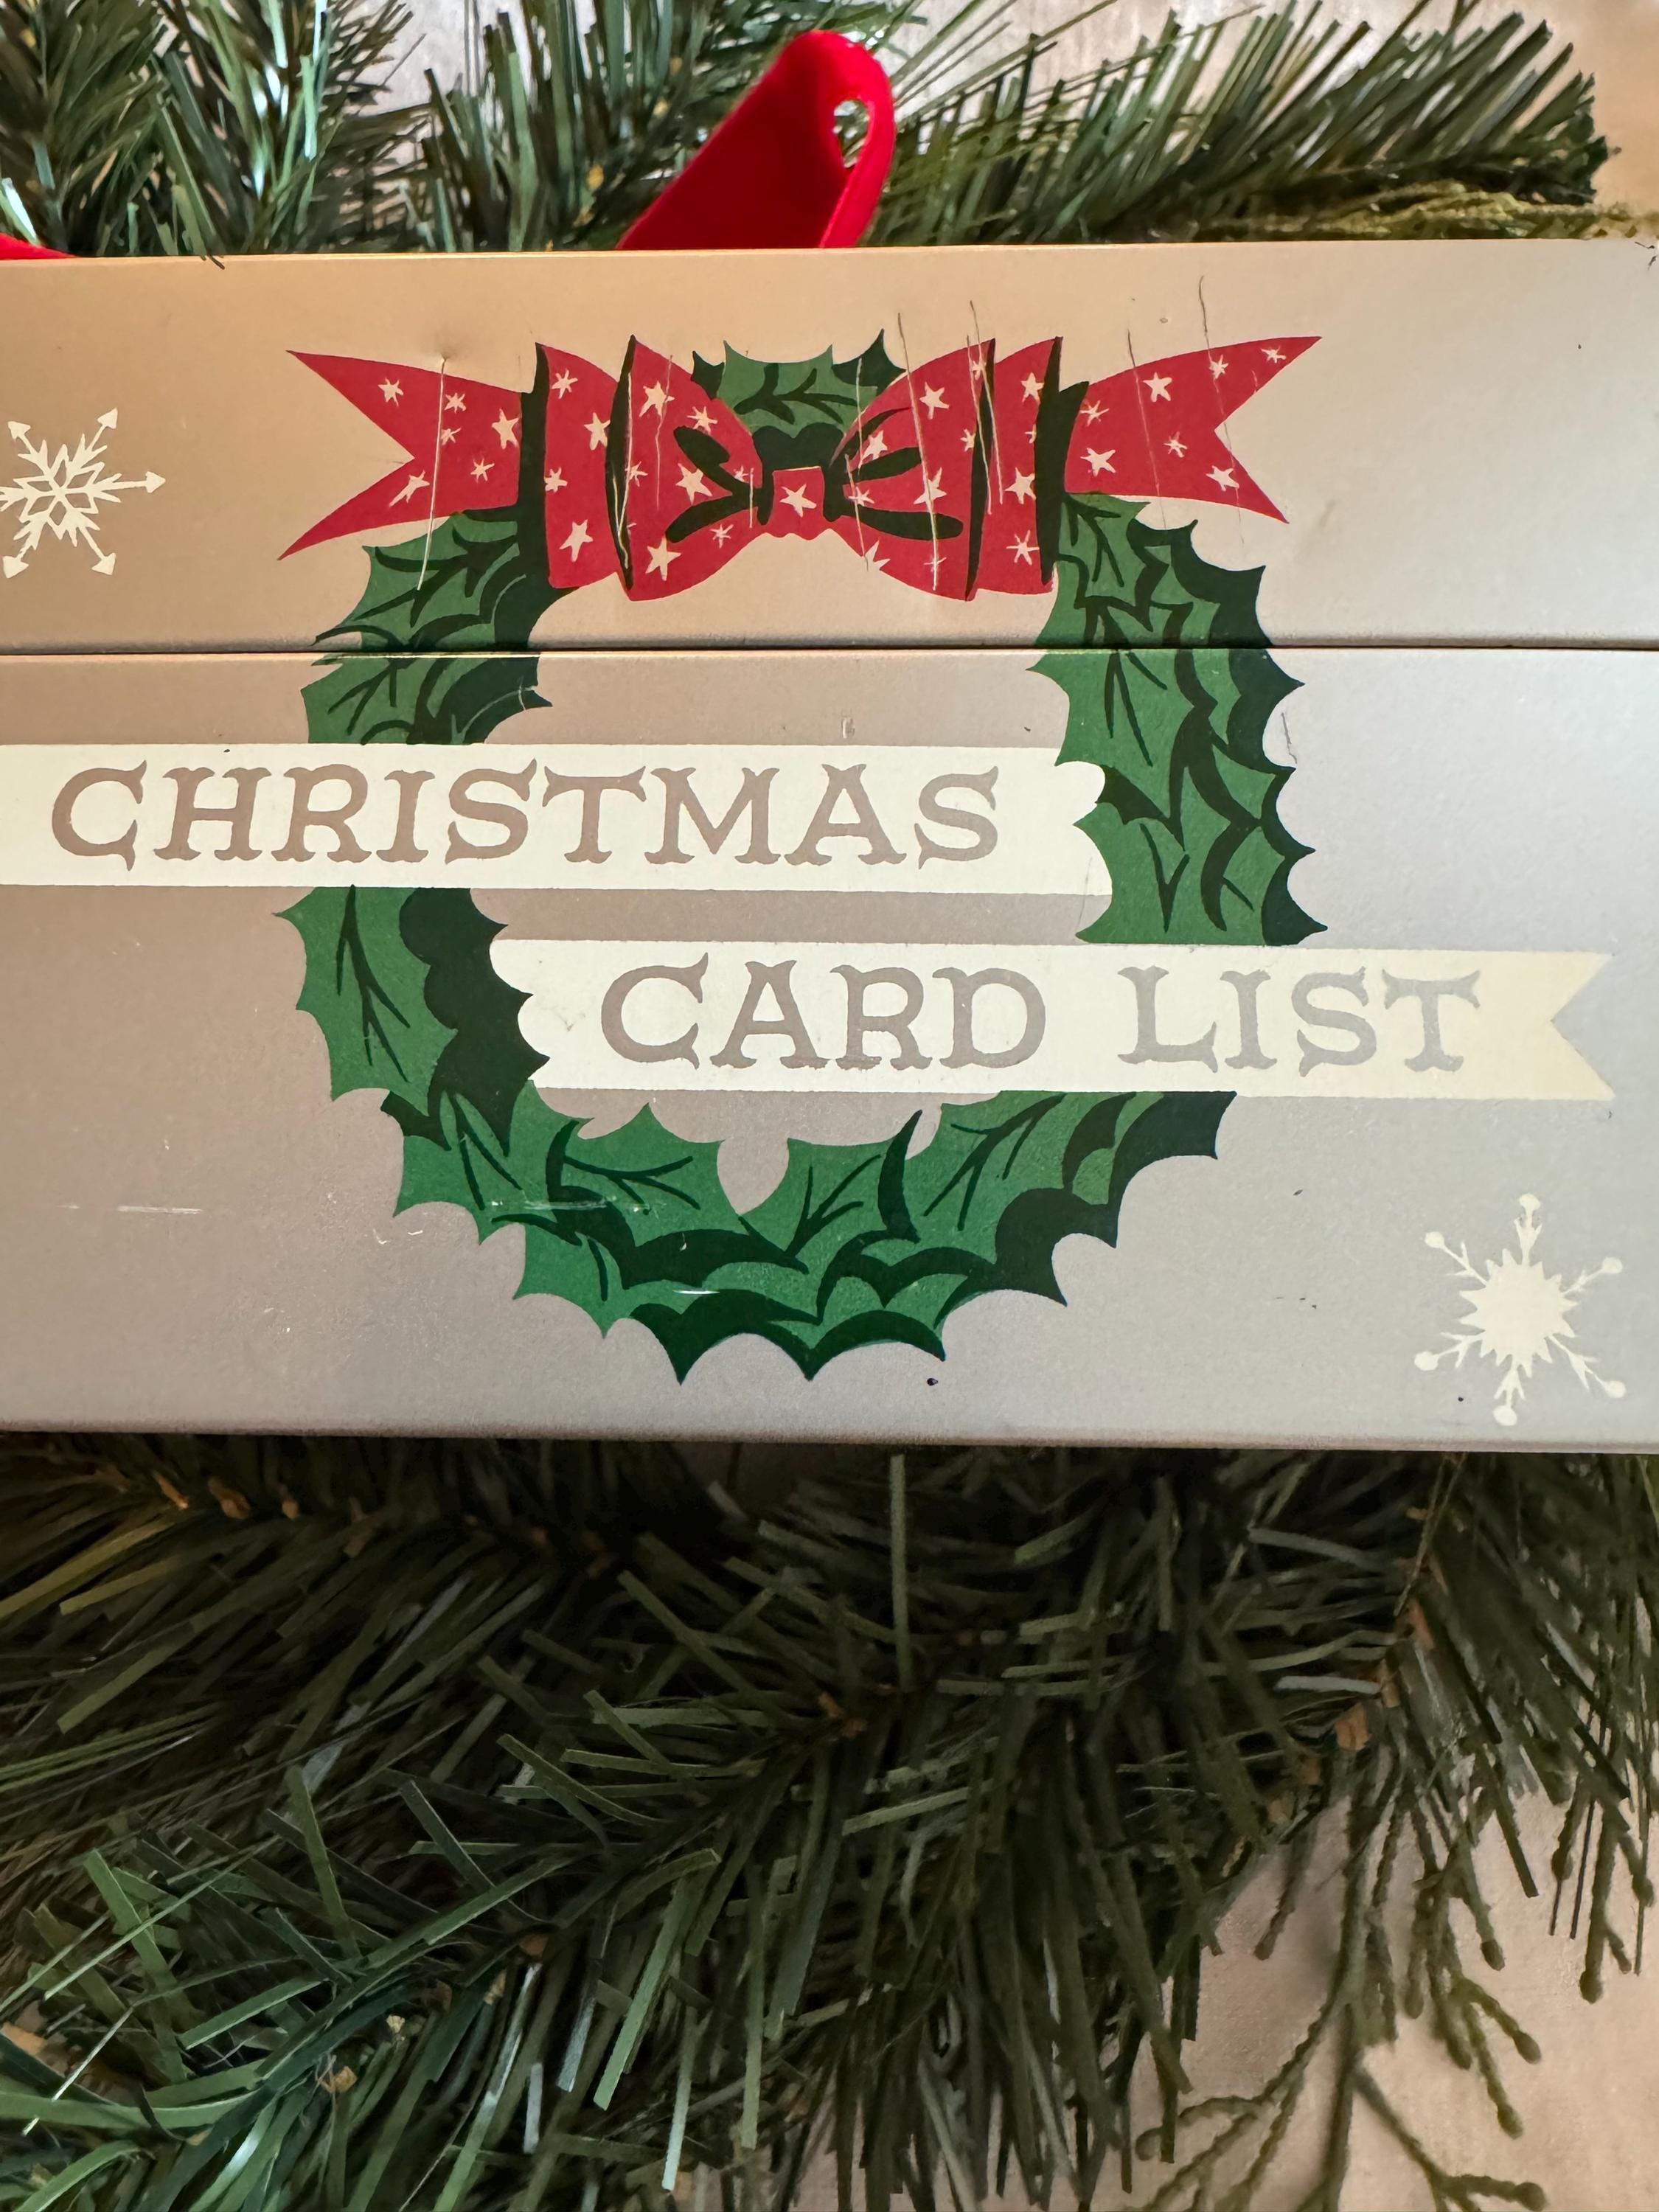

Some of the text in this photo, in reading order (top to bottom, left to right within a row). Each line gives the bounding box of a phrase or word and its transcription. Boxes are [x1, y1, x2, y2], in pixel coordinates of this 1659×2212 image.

[52, 759, 1000, 872] CHRISTMAS
[601, 953, 1480, 1077] CARD LIST
